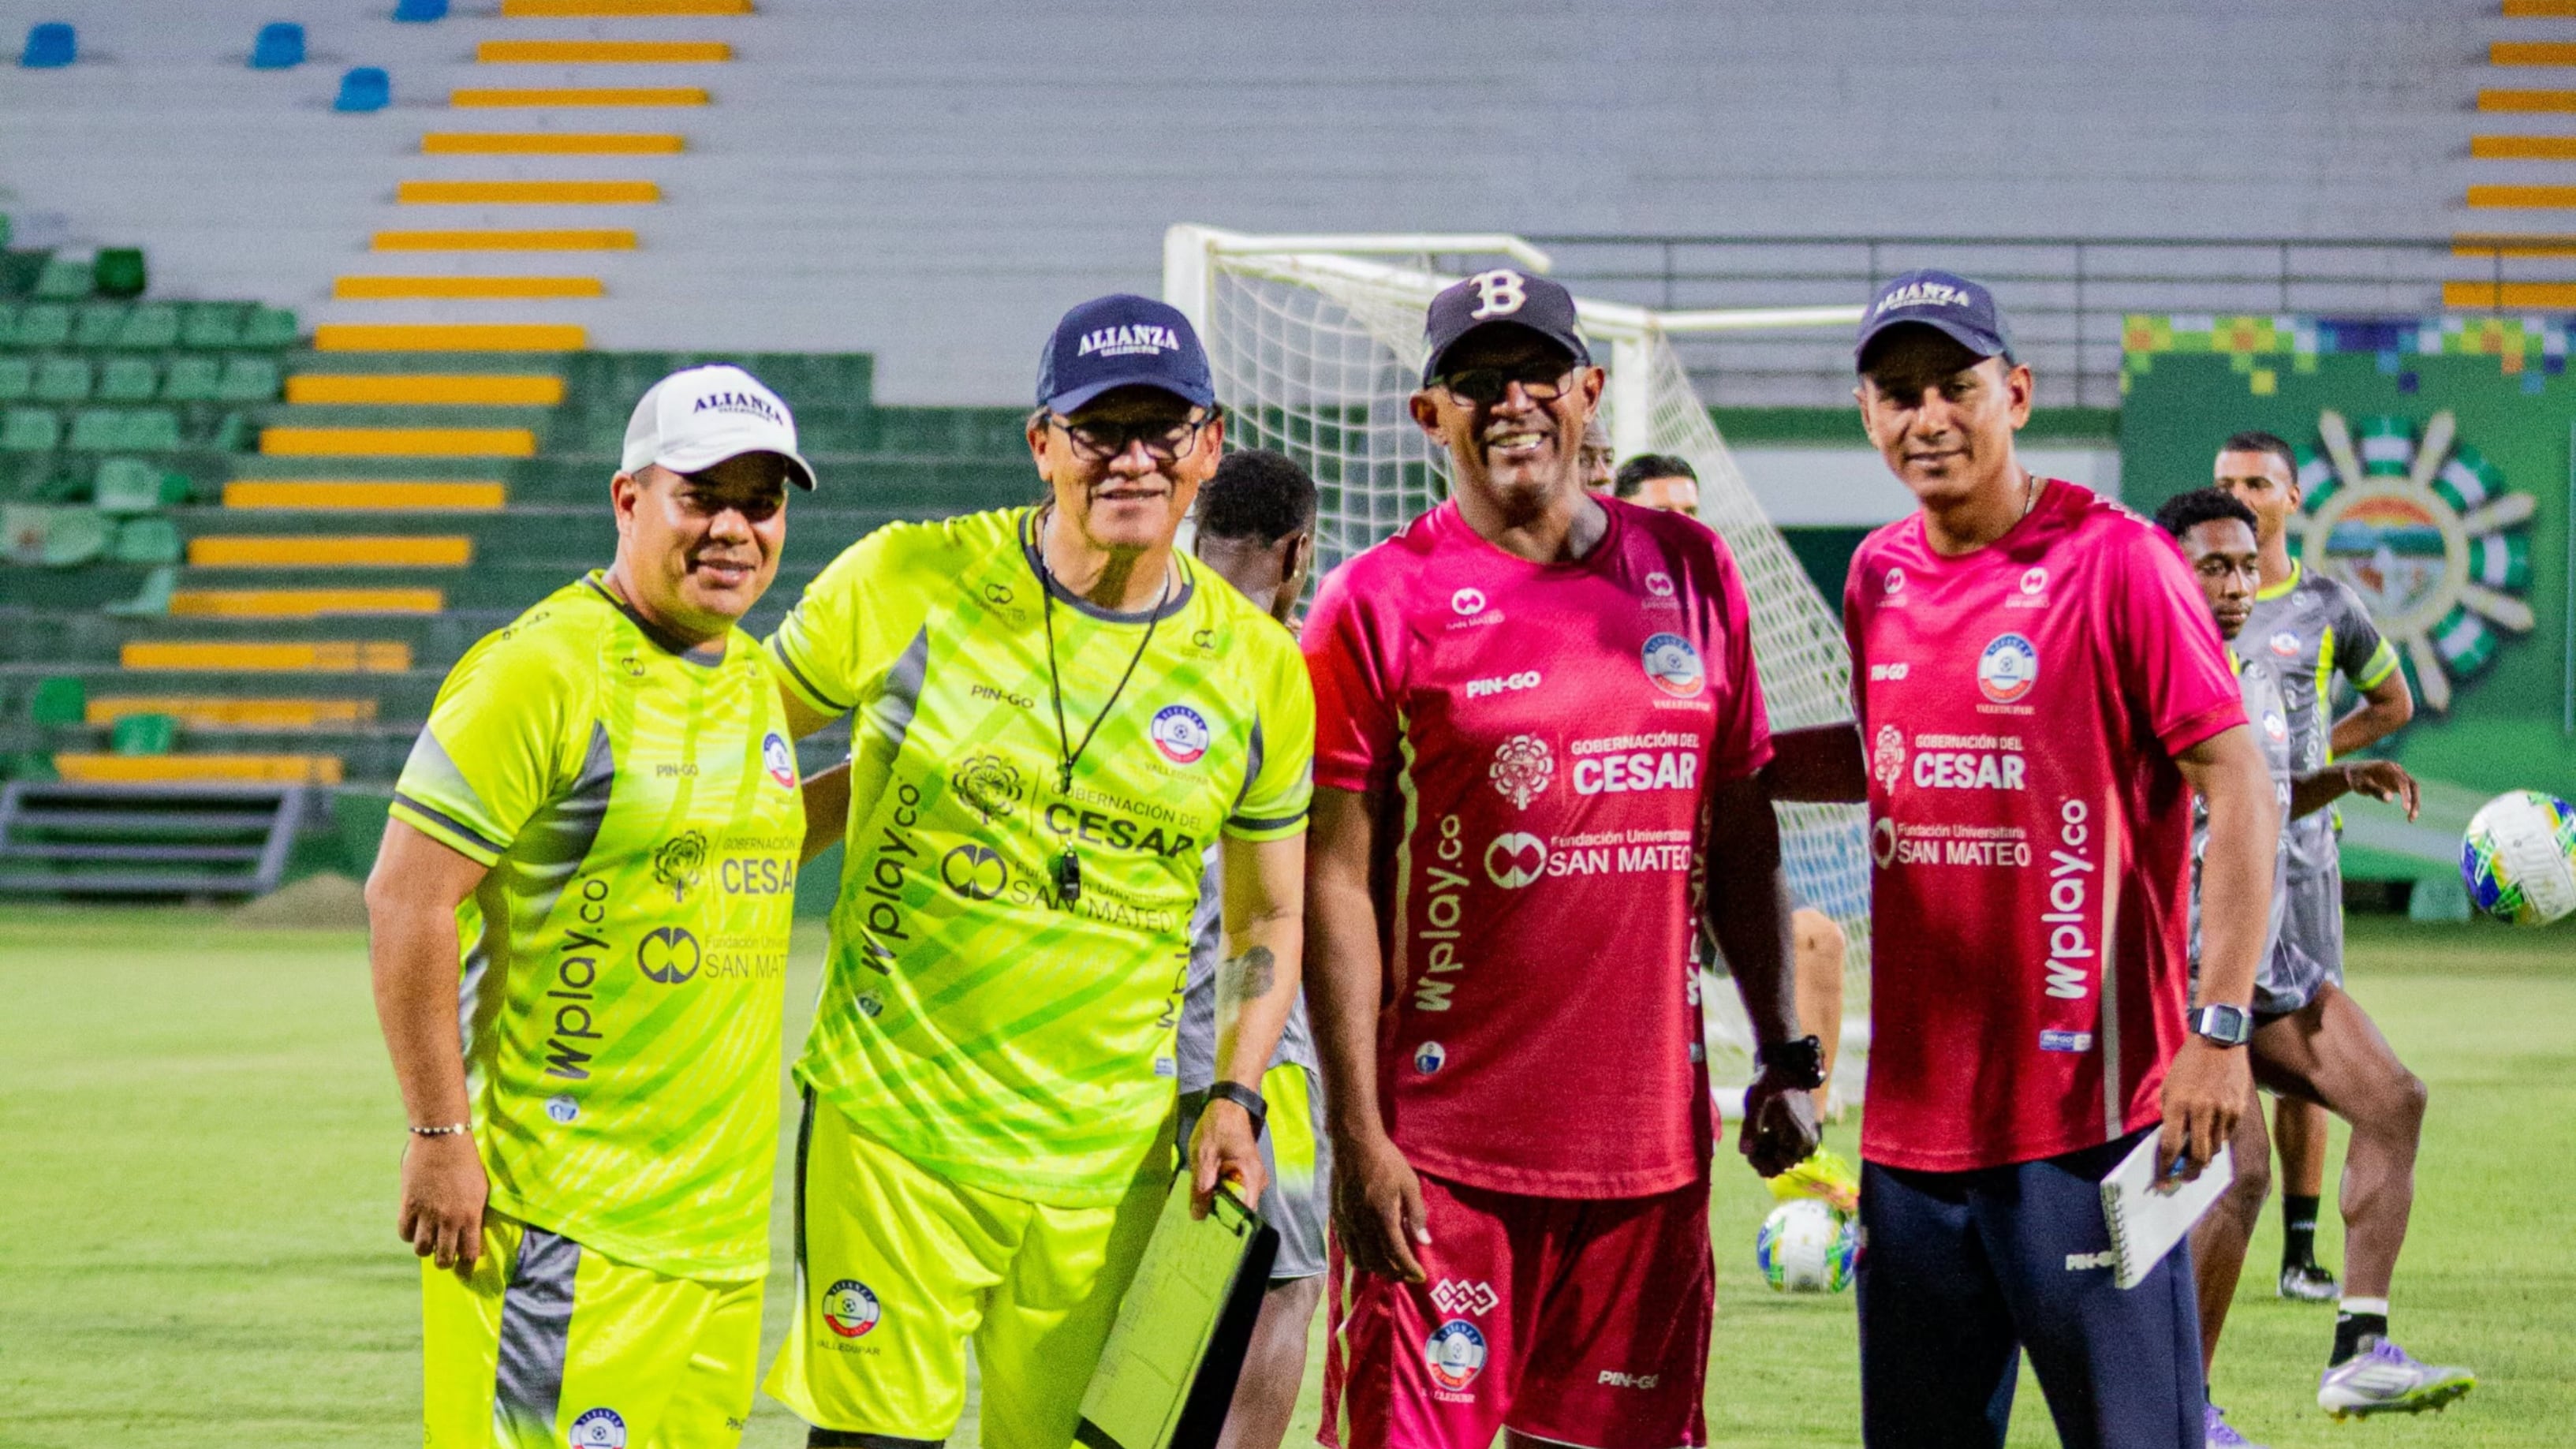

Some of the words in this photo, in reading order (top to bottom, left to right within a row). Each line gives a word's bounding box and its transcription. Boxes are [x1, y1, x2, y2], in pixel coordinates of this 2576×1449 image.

[1469, 269, 1527, 319] B
[1872, 282, 1969, 316] ALIANZA
[1077, 324, 1180, 357] ALIANZA
[693, 393, 783, 426] ALIANZA
[971, 684, 1035, 709] PIN-GO
[1466, 670, 1542, 699] PIN-GO
[1571, 730, 1678, 755] GOBERNACIÓN
[1679, 732, 1700, 748] DEL
[1915, 734, 1998, 749] GOBERNACIÓN
[1999, 736, 2025, 751] DEL
[1573, 752, 1697, 795] CESAR
[1913, 753, 2026, 790] CESAR
[1179, 812, 1202, 829] DEL
[723, 836, 796, 851] GOBERNACIÓN
[1551, 831, 1623, 848] Fundación
[1897, 838, 1939, 865] SAN
[1945, 840, 2033, 868] MATEO
[721, 858, 794, 894] CESA
[1547, 848, 1609, 877] SAN
[1618, 845, 1693, 873] MATEO
[861, 783, 921, 977] Wplay.co
[1088, 896, 1172, 934] MATEO
[1414, 814, 1470, 1011] Wplay.co
[2040, 799, 2095, 999] Wplay.co
[545, 879, 610, 1080] Wplay.co
[704, 954, 749, 979] SAN
[756, 954, 789, 979] MAT
[2065, 1250, 2114, 1271] PIN-G
